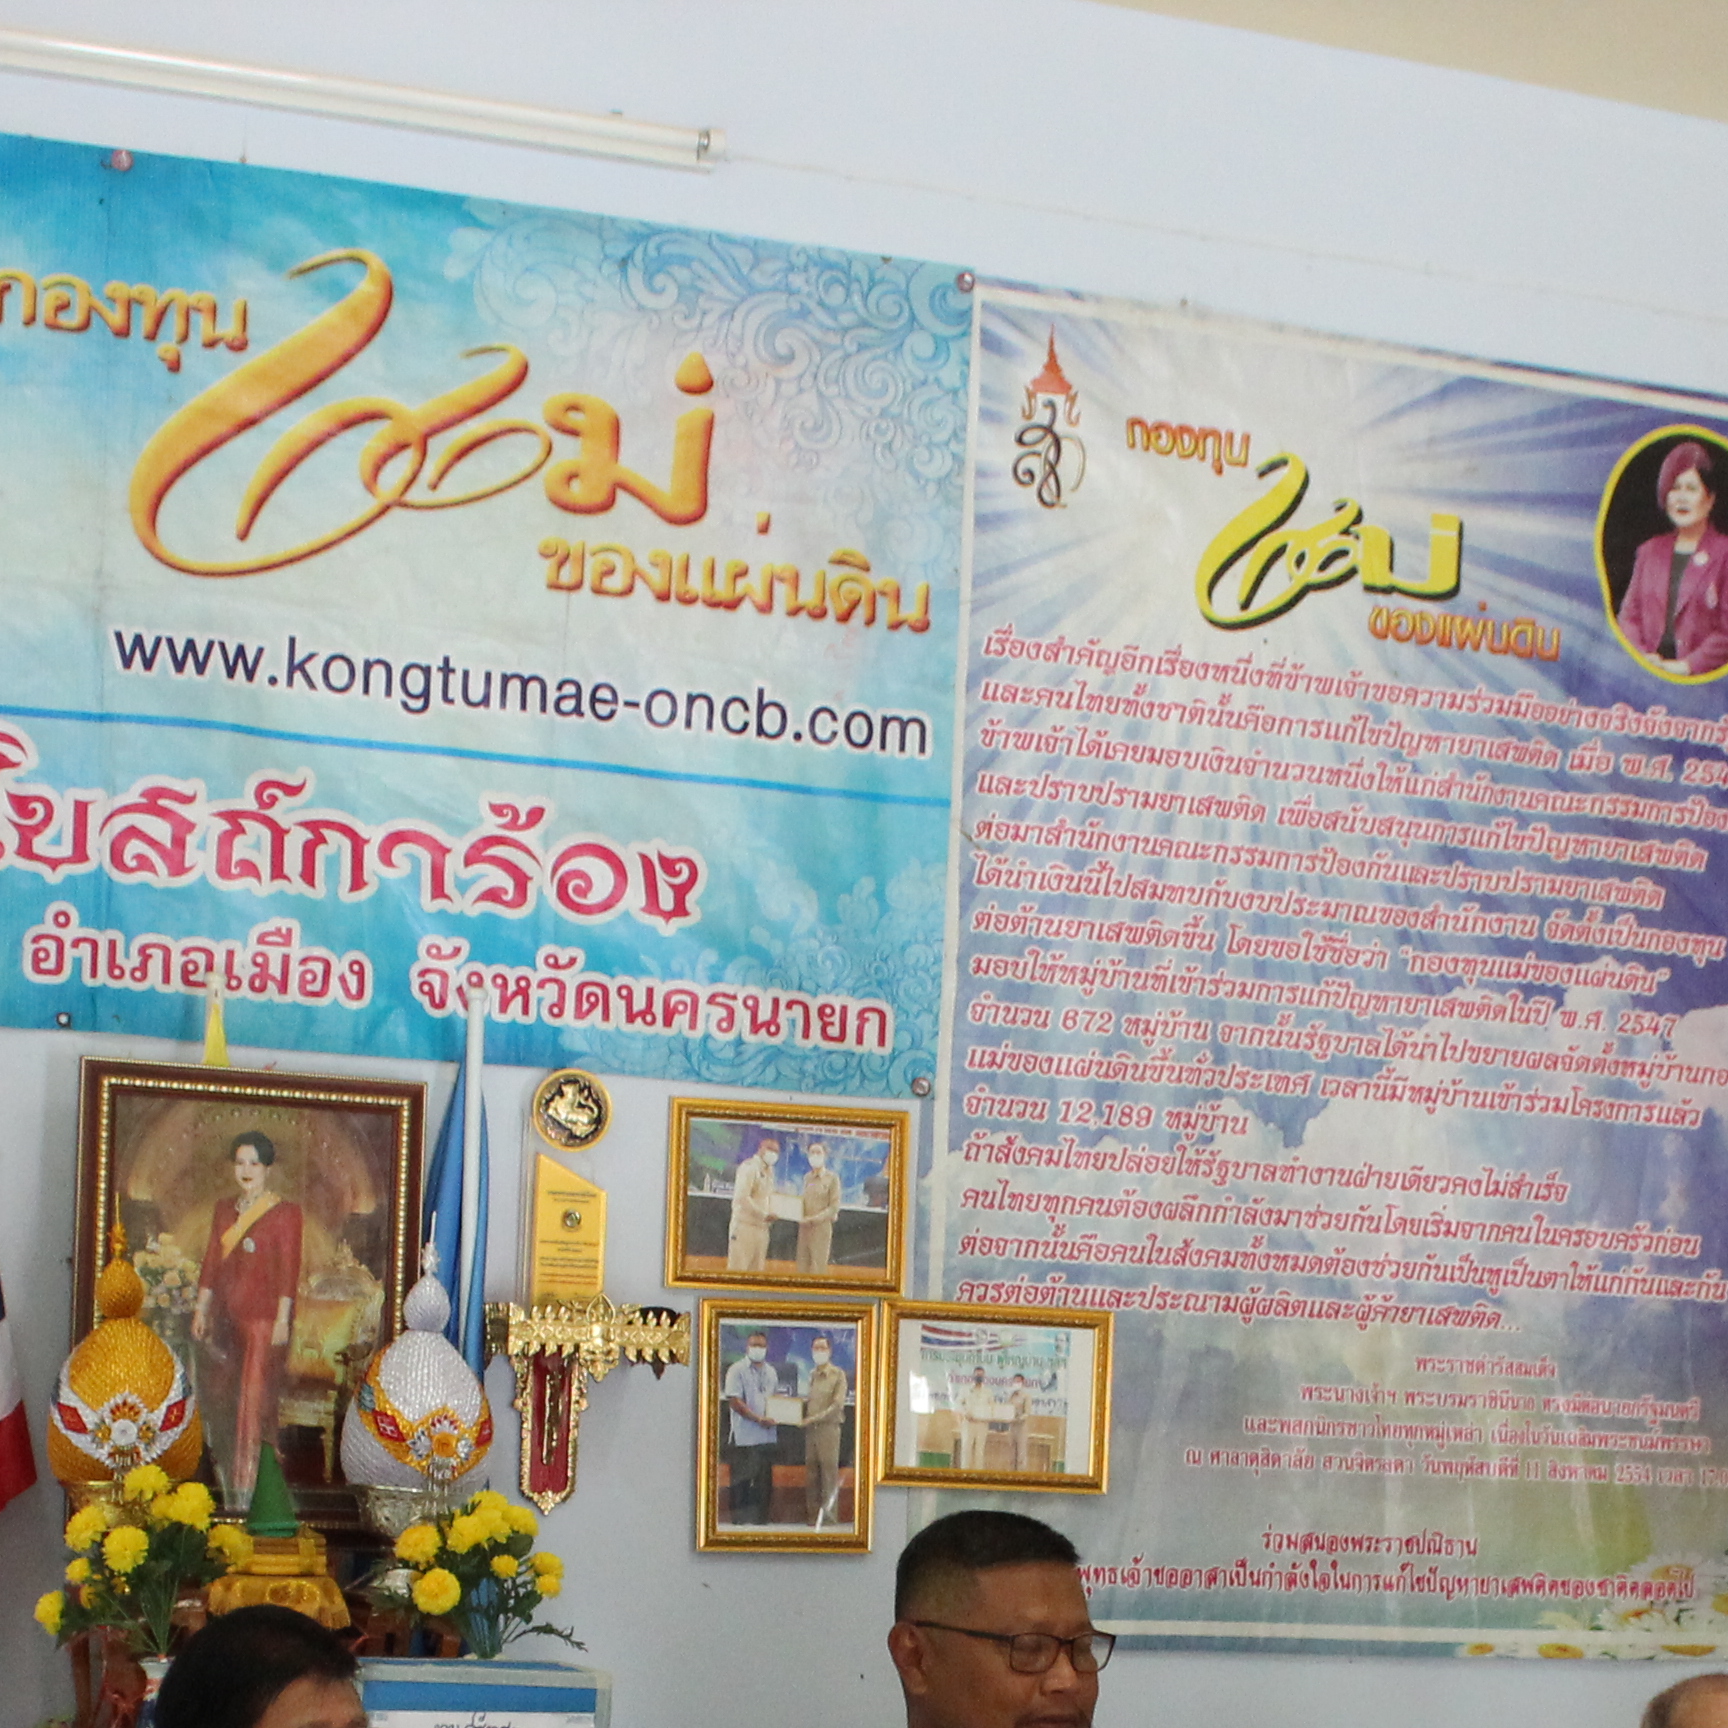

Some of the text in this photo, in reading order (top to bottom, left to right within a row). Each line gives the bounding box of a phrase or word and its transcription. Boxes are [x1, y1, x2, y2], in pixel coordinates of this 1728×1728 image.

[129, 247, 716, 578] แม่
[1126, 417, 1250, 476] กองทุน
[538, 511, 930, 632] ของแผ่นดิน
[1367, 605, 1561, 661] ของแผ่นดิน
[113, 626, 928, 756] www.kongtumae-oncb.com
[981, 678, 1560, 768] และคนไทยทั้งชาตินั้นคือการแก้ไขปัญหายาเสพติด
[1566, 741, 1614, 774] เมื่อ
[977, 769, 1709, 872] และปราบปรามยาเสพติด เพื่อสนับสนุนการแก้ไขปัญหายาเสพติด
[975, 814, 1666, 911] ต่อมาสำนักงานคณะกรรมการป้องกันและปราบปรามยาเสพติด
[971, 903, 1216, 952] ต่อต้านยาเสพติดขึ้น
[1226, 922, 1389, 969] โดยขอใช้ชื่อว่า
[973, 853, 1726, 966] ได้นำเงินนี้ไปสมทบกับงบประมาณของสำนักงาน จัดตั้งเป็นกองทุน
[31, 912, 368, 1002] อำเภอเมือง
[415, 944, 889, 1050] จังหวัดนครนายก
[970, 949, 1678, 1038] มอบให้หมู่บ้านที่เข้าร่วมการแก้ปัญหายาเสพติดในปี พ.ศ. 2547
[970, 993, 1049, 1031] จำนวน
[1060, 1008, 1113, 1034] 672
[1122, 1010, 1210, 1048] หมู่บ้าน
[965, 1086, 1249, 1142] จำนวน 12,189 หมู่บ้าน
[967, 1042, 1704, 1130] แม่ของแผ่นดินขึ้นทั่วประเทศ เวลานี้มีหมู่บ้านเข้าร่วมโครงการแล้ว
[963, 1130, 1570, 1204] ถ้าสังคมไทยปล่อยให้รัฐบาลทำงานฝ่ายเดียวคงไม่สำเร็จ
[1415, 1352, 1557, 1380] พระราชดำรัสสมเด็จ
[1243, 1413, 1483, 1450] และพสกนิกรชาวไทยทุกหมู่เหล่า
[1077, 1551, 1695, 1604] พุทธเจ้าขออาสาเป็นกำลังใจในการแก้ไขปัญหายาเสพติดของชาติตลอดไป
[1261, 1523, 1479, 1558] ร่วมสนองพระราชปณิธาน
